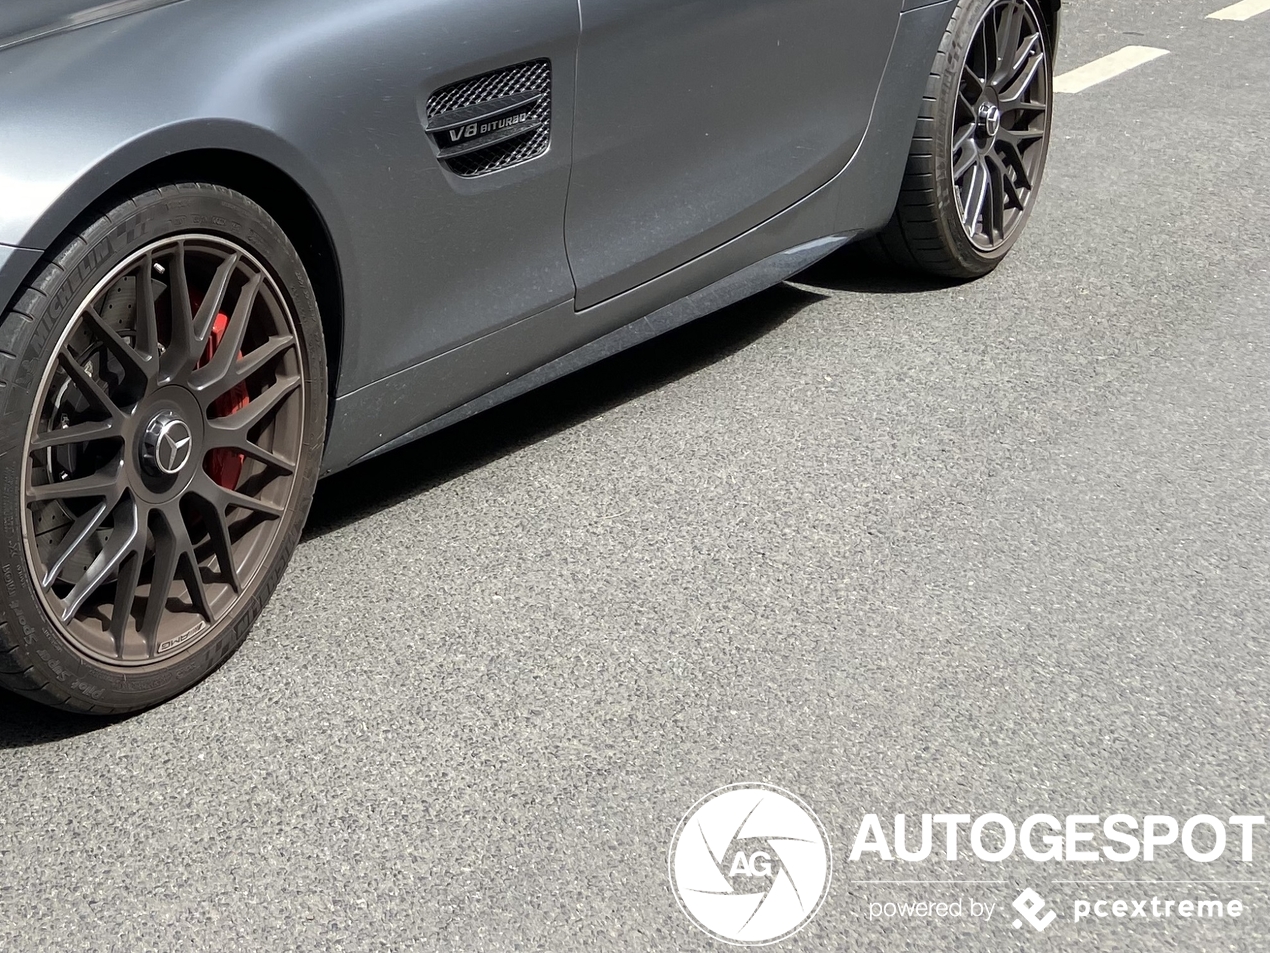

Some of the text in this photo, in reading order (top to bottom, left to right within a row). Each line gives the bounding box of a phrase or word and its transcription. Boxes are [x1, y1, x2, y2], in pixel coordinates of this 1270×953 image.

[449, 112, 528, 142] V8 BITURBO
[29, 234, 115, 352] MICHELIN
[9, 601, 38, 647] Sport
[35, 648, 72, 683] Super
[70, 677, 105, 700] Pilot
